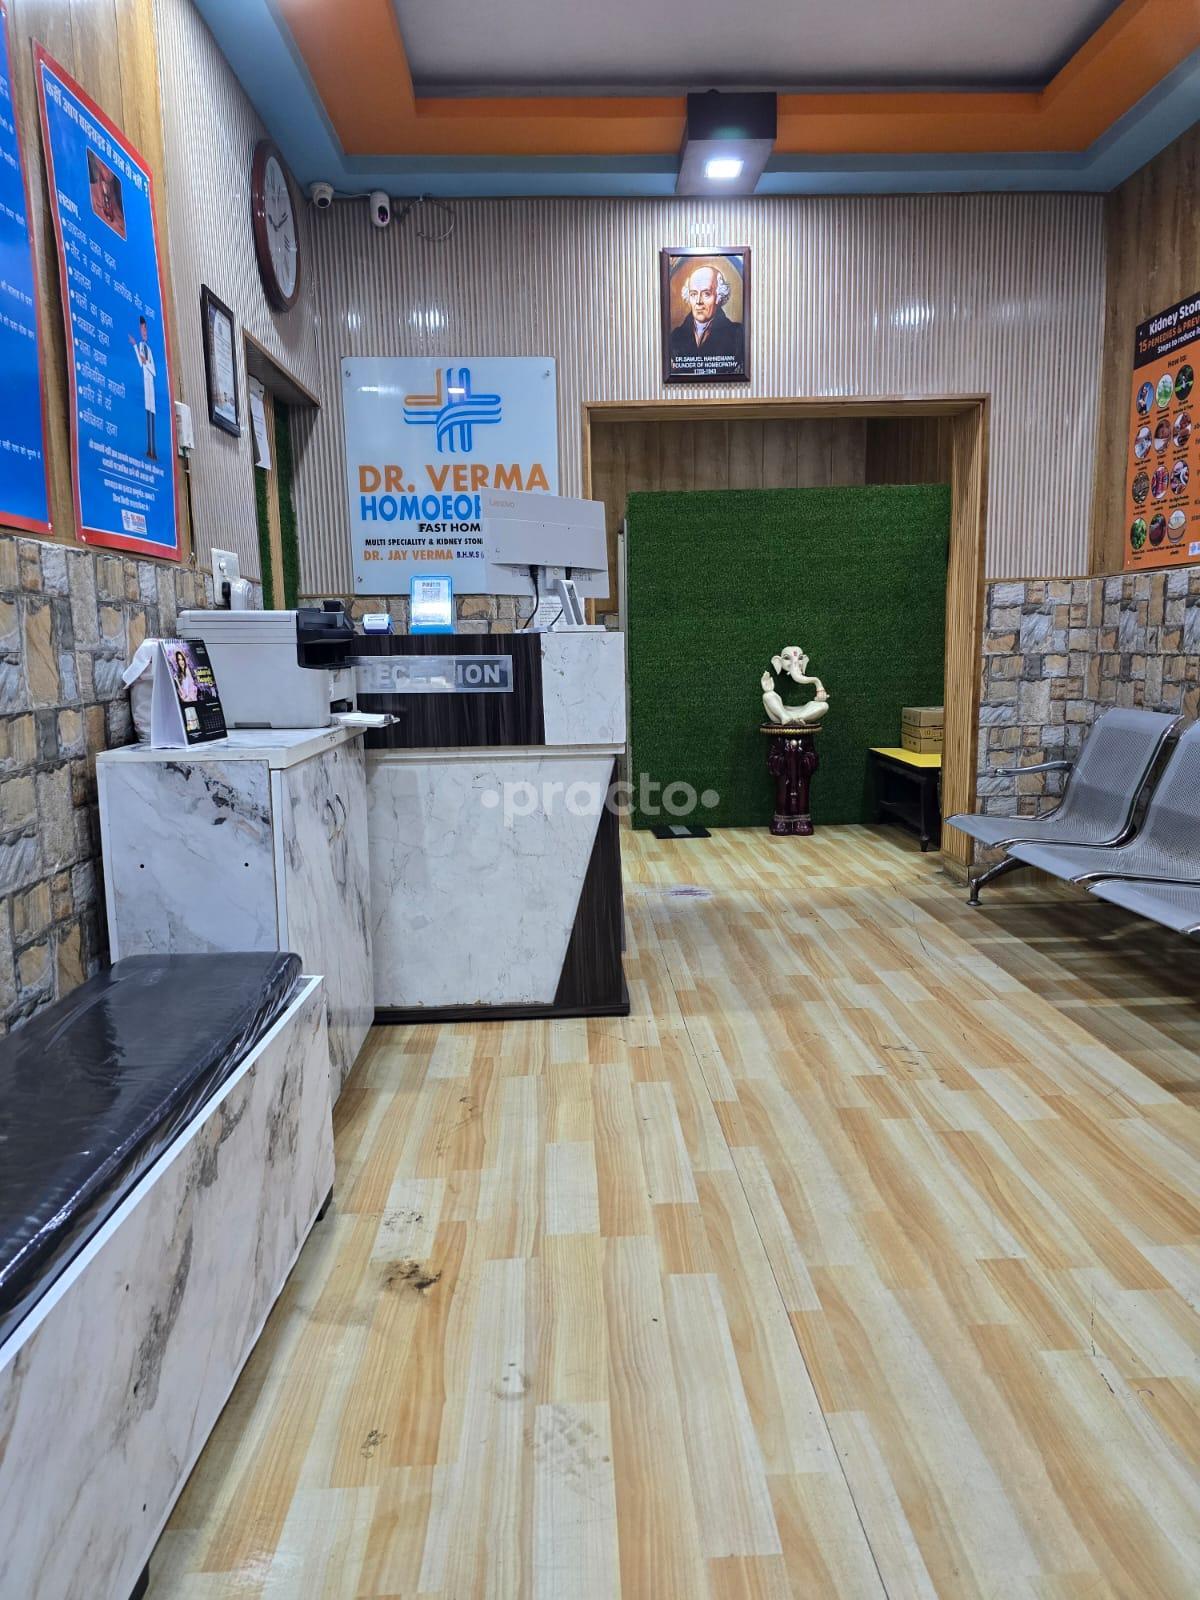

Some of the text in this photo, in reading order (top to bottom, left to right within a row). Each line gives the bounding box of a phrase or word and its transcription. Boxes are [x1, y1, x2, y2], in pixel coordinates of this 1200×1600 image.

[1150, 312, 1178, 336] Kidney
[1158, 342, 1171, 354] Steps
[358, 463, 550, 493] DR. VERMA
[418, 523, 481, 532] FAST HOM
[388, 538, 426, 546] SPECIALITY
[364, 550, 384, 561] DR.
[388, 550, 408, 560] JAY
[413, 550, 454, 560] VERMA
